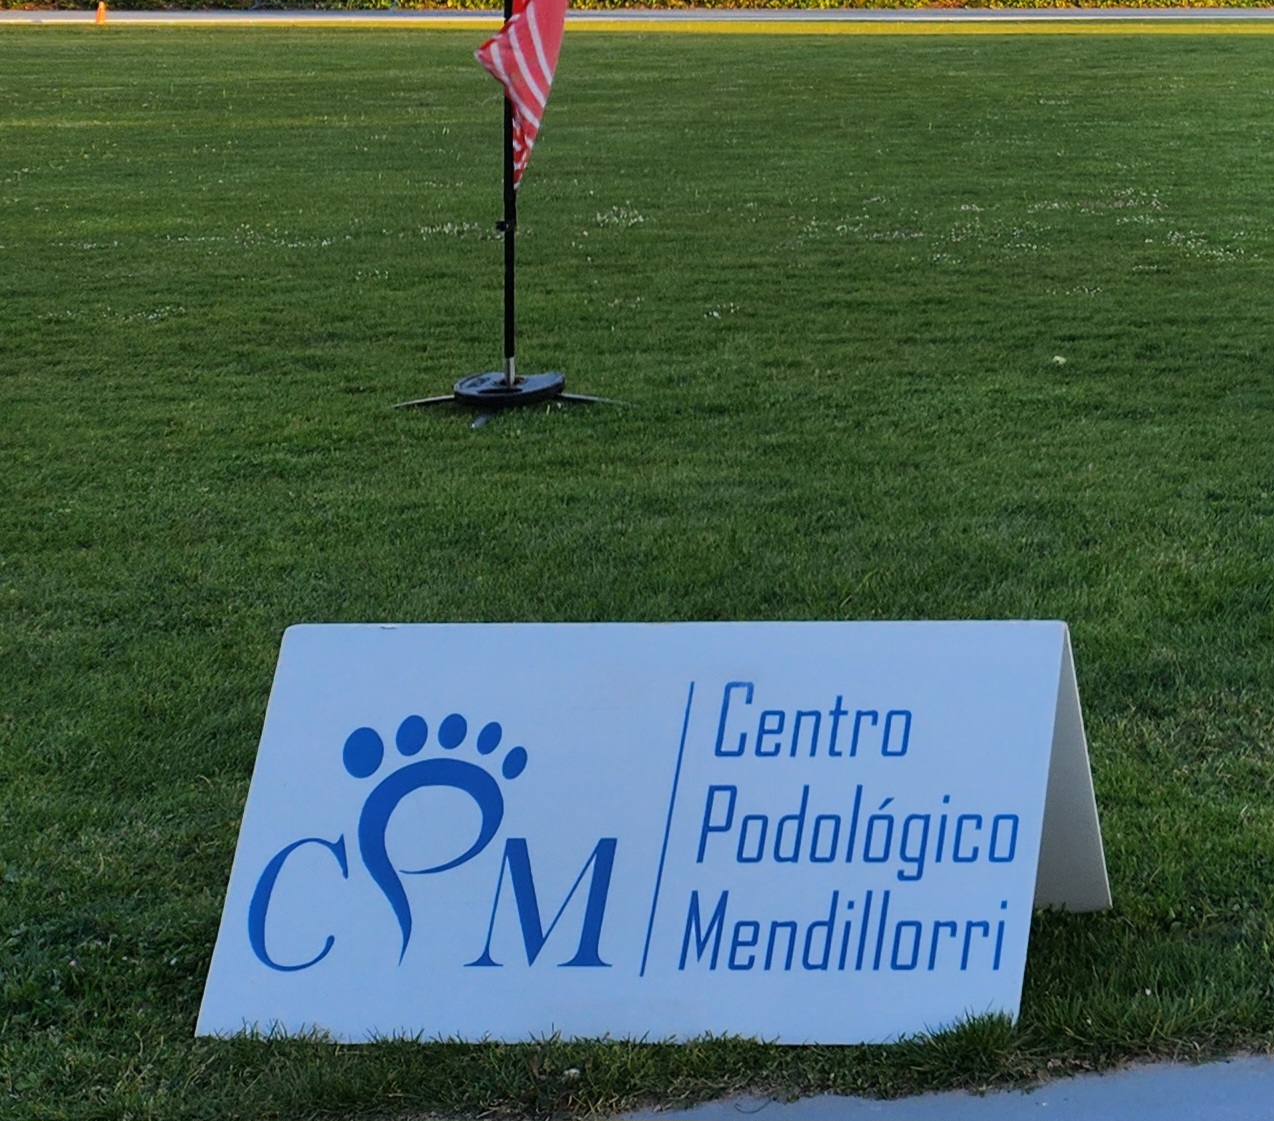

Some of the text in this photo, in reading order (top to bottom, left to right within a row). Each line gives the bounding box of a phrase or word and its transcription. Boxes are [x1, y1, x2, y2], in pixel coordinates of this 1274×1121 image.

[714, 681, 911, 757] Centro
[696, 784, 1019, 881] Podológico
[678, 889, 1006, 972] Mendillorri
